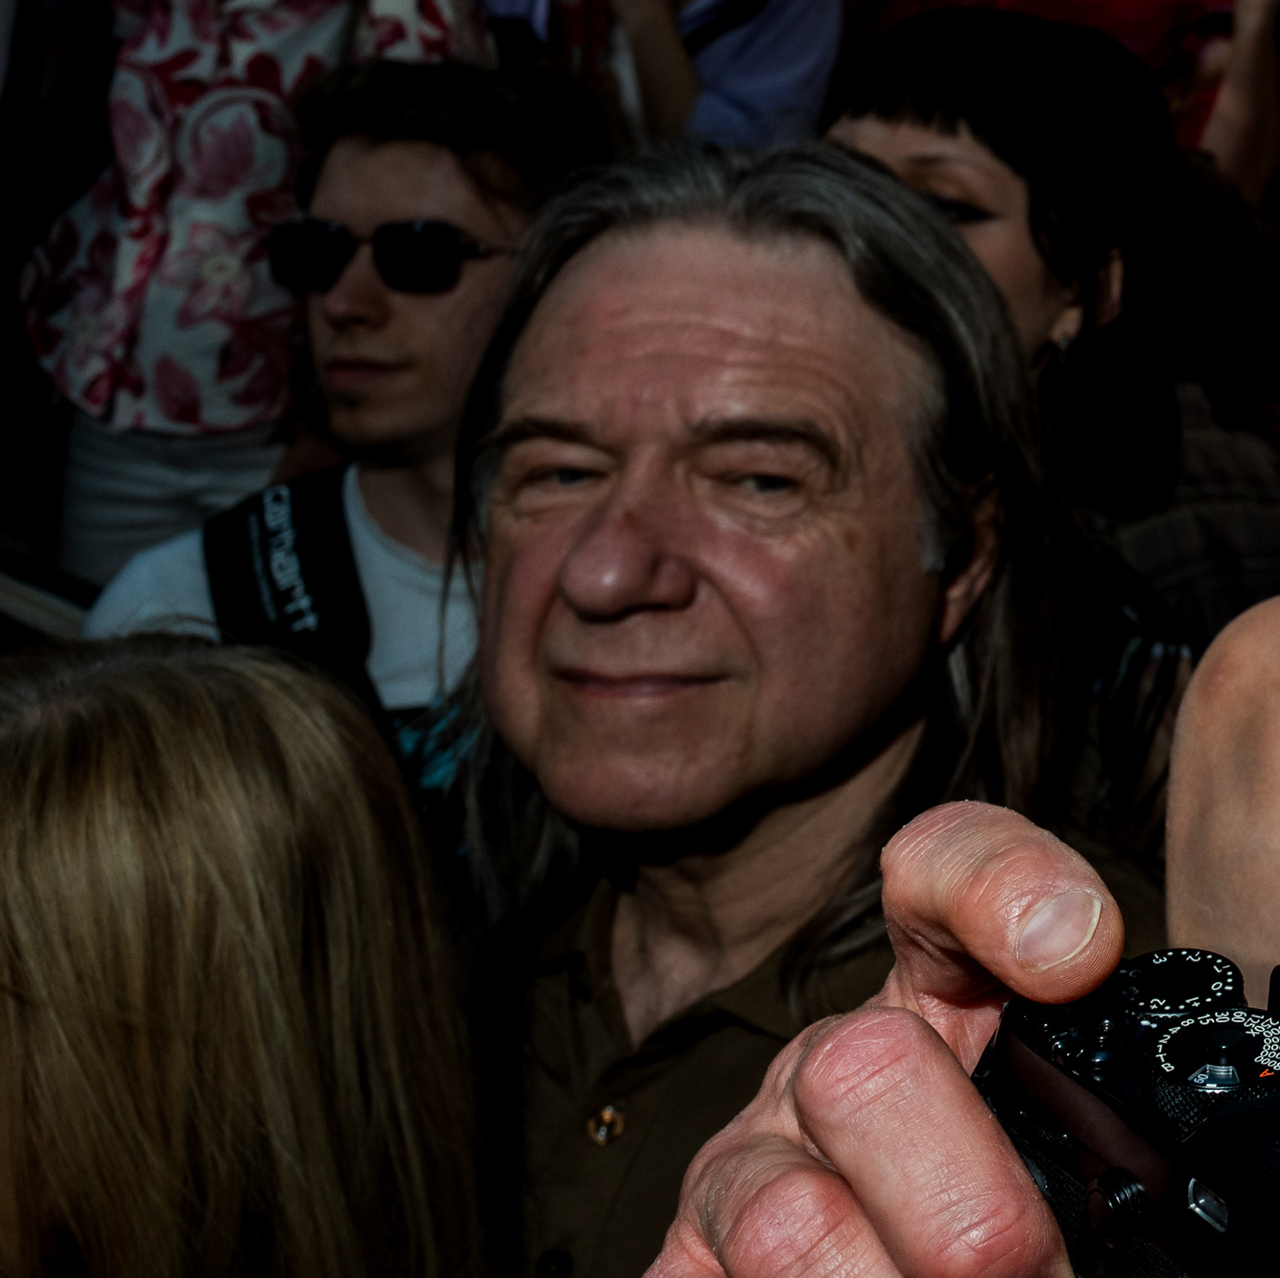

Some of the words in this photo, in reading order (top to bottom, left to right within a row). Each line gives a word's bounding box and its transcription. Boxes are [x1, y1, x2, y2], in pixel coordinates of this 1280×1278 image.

[1197, 1014, 1215, 1025] 15
[1215, 1011, 1230, 1022] 30
[1231, 1011, 1247, 1022] 60
[1181, 1019, 1194, 1027] 8
[1169, 1026, 1181, 1034] 4
[1159, 1035, 1170, 1043] 2
[1155, 1053, 1166, 1062] T
[1161, 1063, 1174, 1072] B
[1259, 1068, 1274, 1077] A
